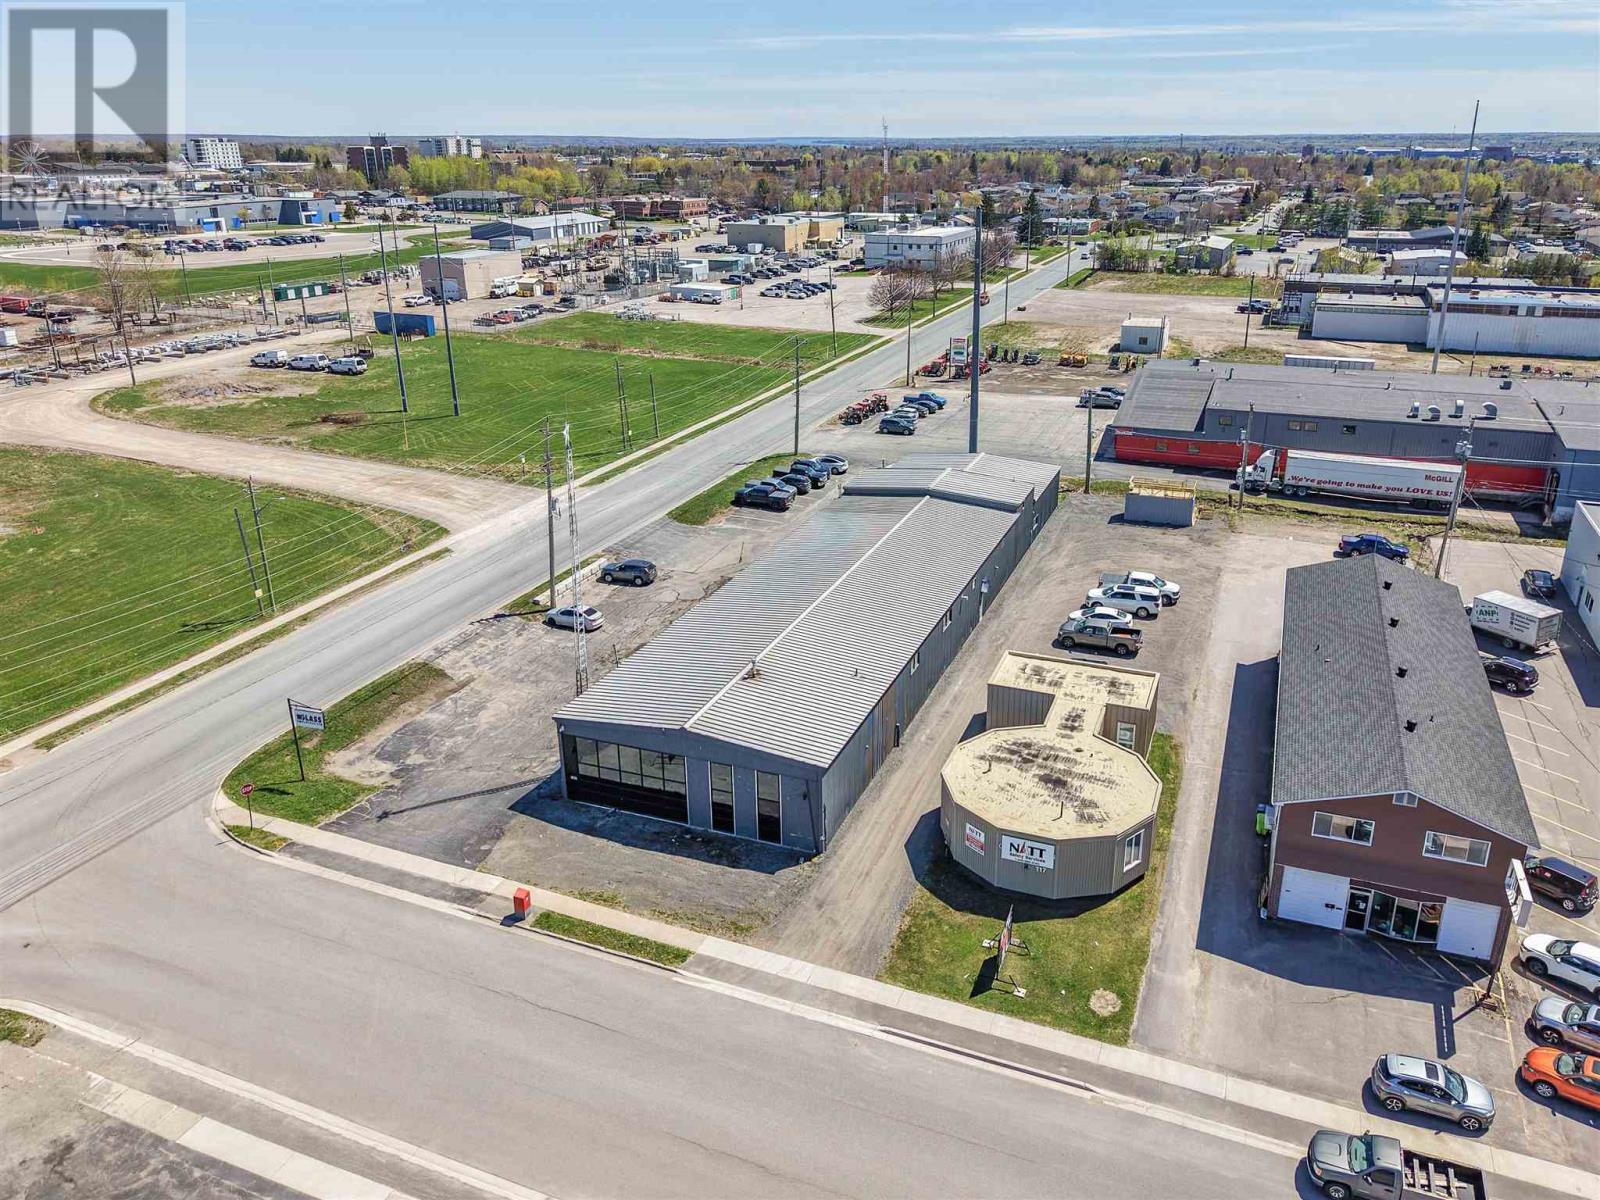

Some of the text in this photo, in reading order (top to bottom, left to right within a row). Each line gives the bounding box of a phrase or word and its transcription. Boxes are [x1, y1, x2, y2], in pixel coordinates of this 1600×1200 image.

[1424, 474, 1454, 483] McGILL
[1316, 479, 1343, 487] going
[1406, 487, 1434, 496] LOVE
[1009, 841, 1047, 858] NATT
